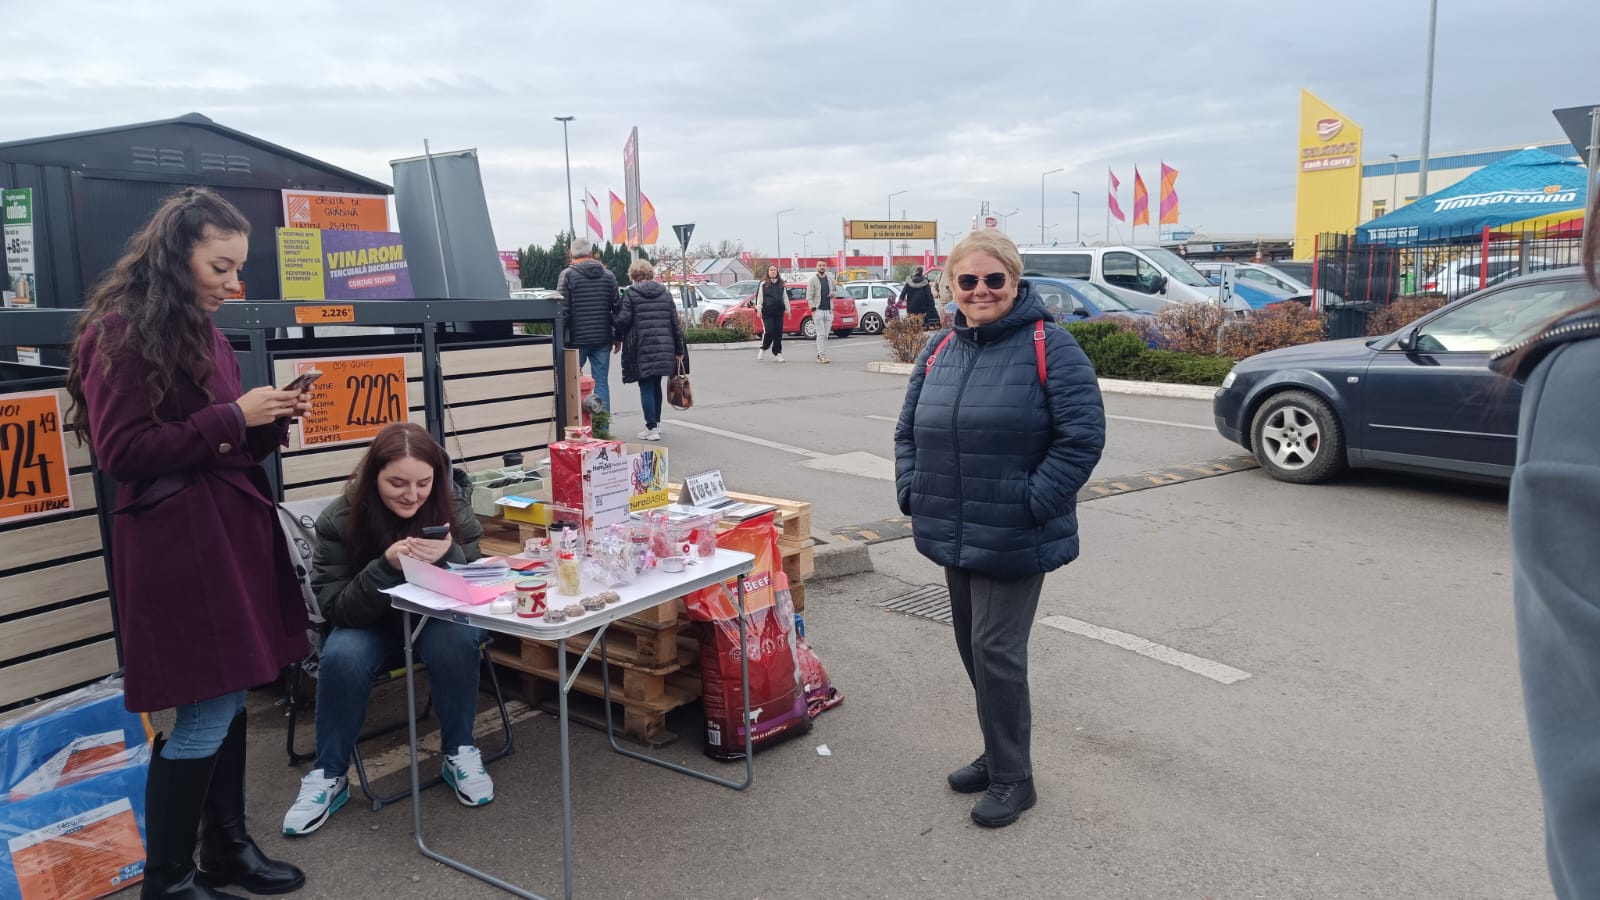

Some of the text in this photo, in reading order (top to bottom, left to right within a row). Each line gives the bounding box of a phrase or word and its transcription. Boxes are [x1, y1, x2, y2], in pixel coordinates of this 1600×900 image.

[327, 245, 403, 269] VINAROM
[322, 309, 348, 318] 2.226
[346, 372, 401, 426] 2226
[40, 412, 56, 433] 19
[743, 576, 770, 592] BEEF
